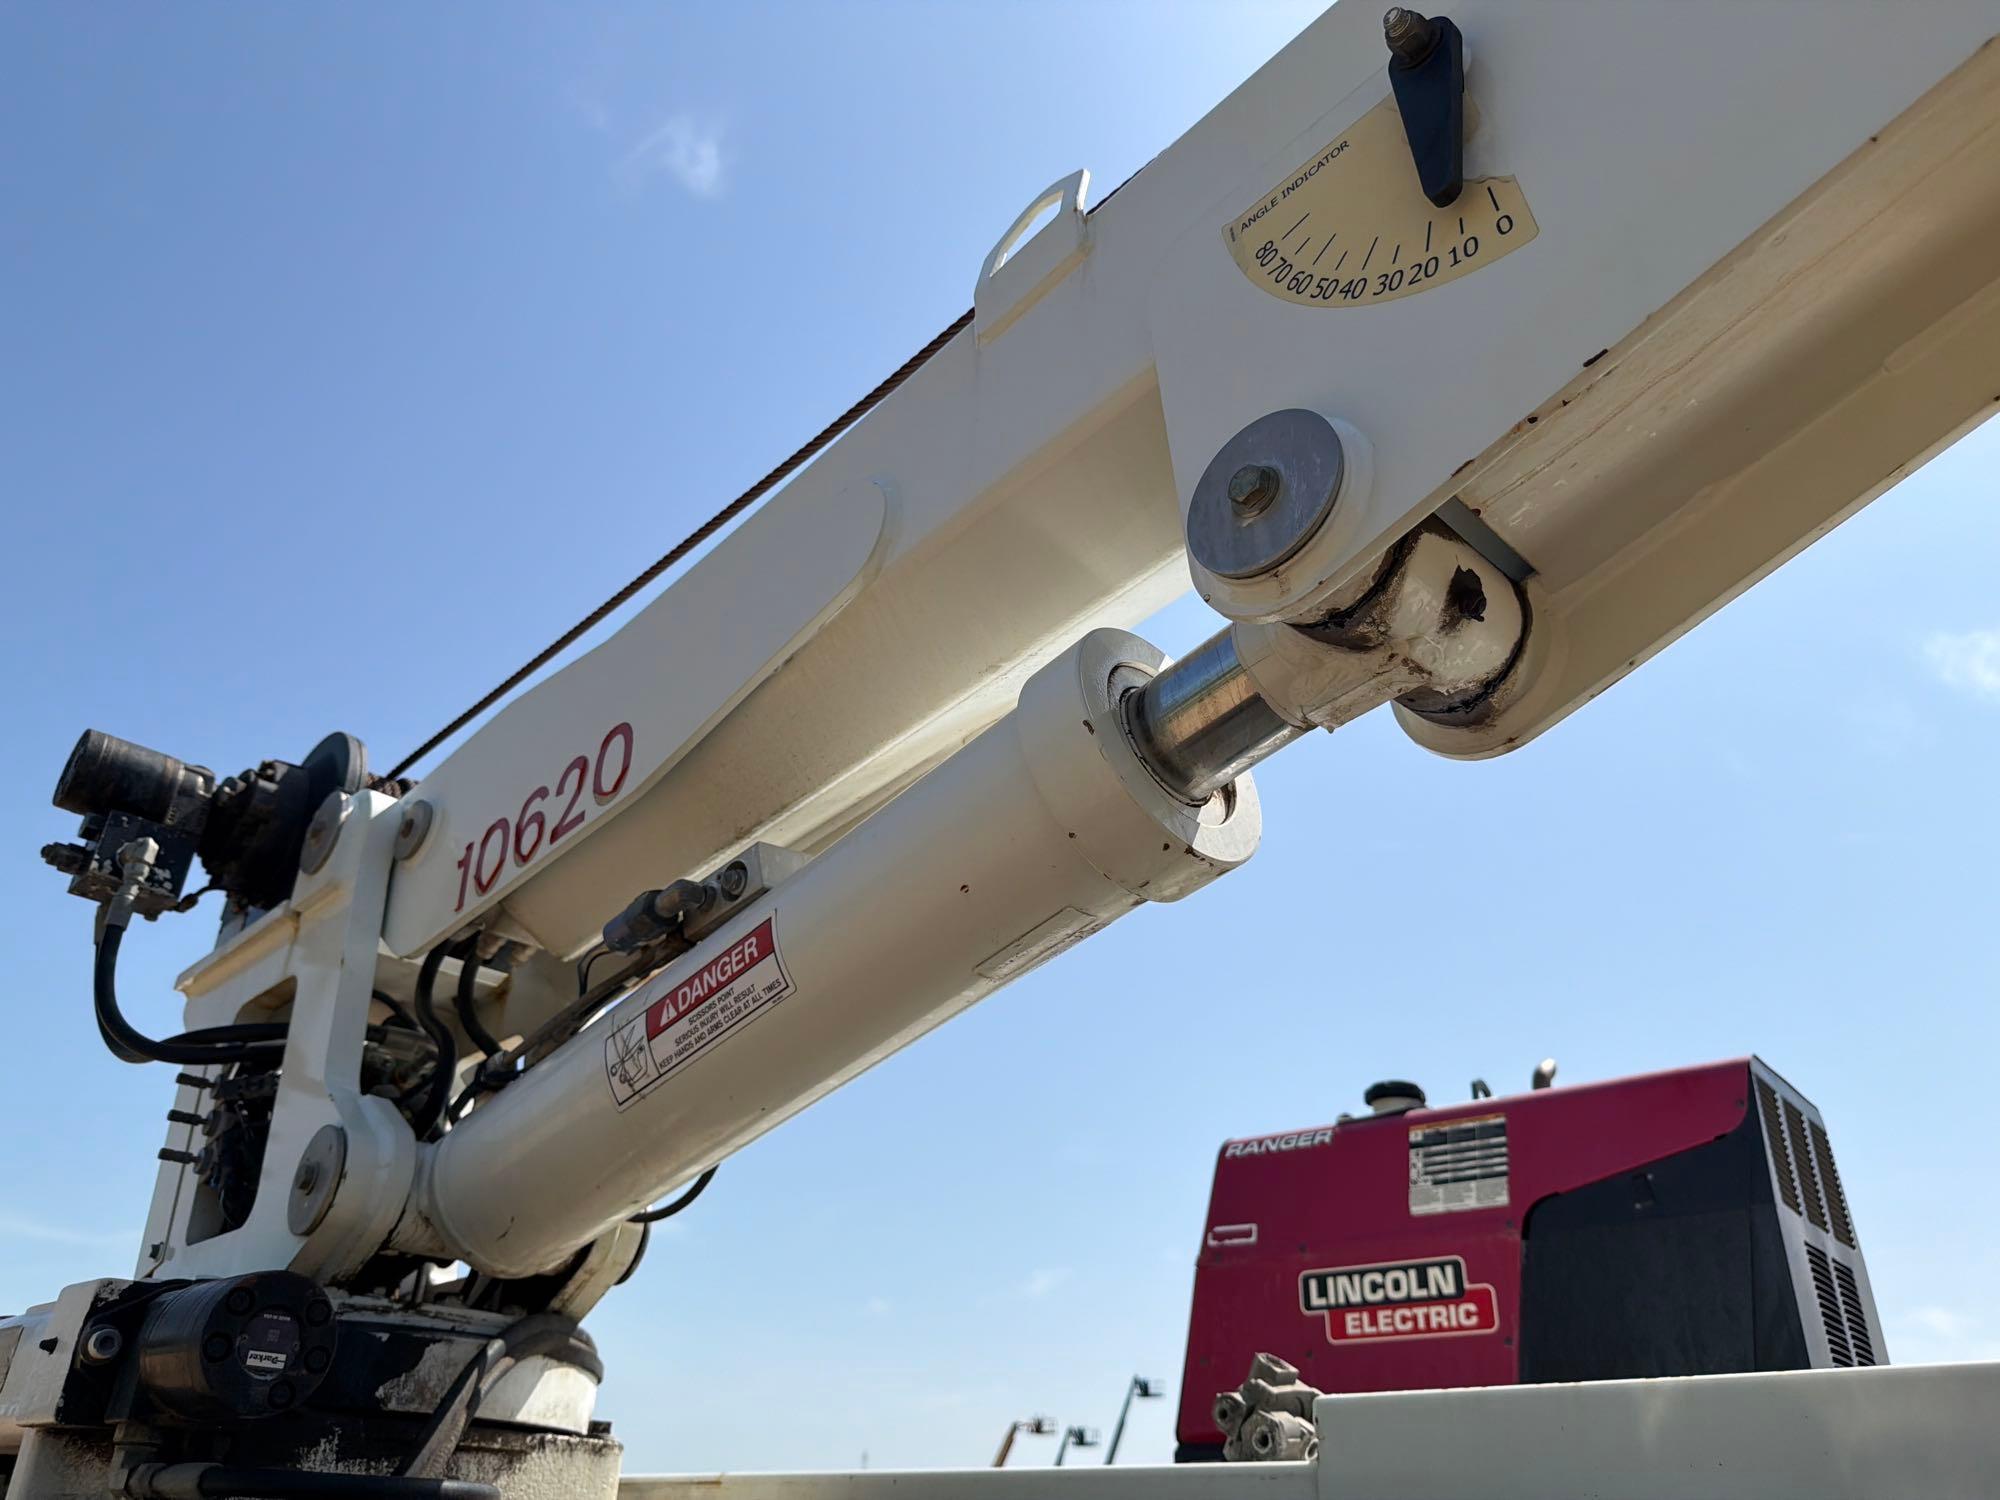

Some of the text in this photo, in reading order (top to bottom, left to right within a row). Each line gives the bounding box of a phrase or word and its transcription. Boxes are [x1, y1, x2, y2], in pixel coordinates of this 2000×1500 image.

[1239, 140, 1350, 232] ANGLE INDICATOR
[1255, 214, 1514, 300] 80 70 60 50 40 30 20 10 0
[454, 722, 634, 912] 10620
[677, 936, 759, 1012] DANGER
[659, 1054, 674, 1070] KEEP
[674, 1040, 694, 1059] HANDS
[694, 1030, 708, 1046] AND
[707, 1021, 724, 1037] ARMS
[724, 1006, 743, 1025] CLEAR
[751, 992, 763, 1006] ALL
[763, 978, 782, 997] TIMES
[674, 1025, 699, 1047] SERIOUS
[700, 1011, 719, 1030] INJURY
[720, 1002, 734, 1015] WILL
[733, 984, 755, 1004] RESULT
[688, 988, 735, 1026] SCISSORS POINT
[1225, 1130, 1333, 1158] RANGER
[1308, 1263, 1458, 1308] LINCOLN
[1344, 1302, 1479, 1335] ELECTRIC
[249, 1353, 279, 1364] Parker
